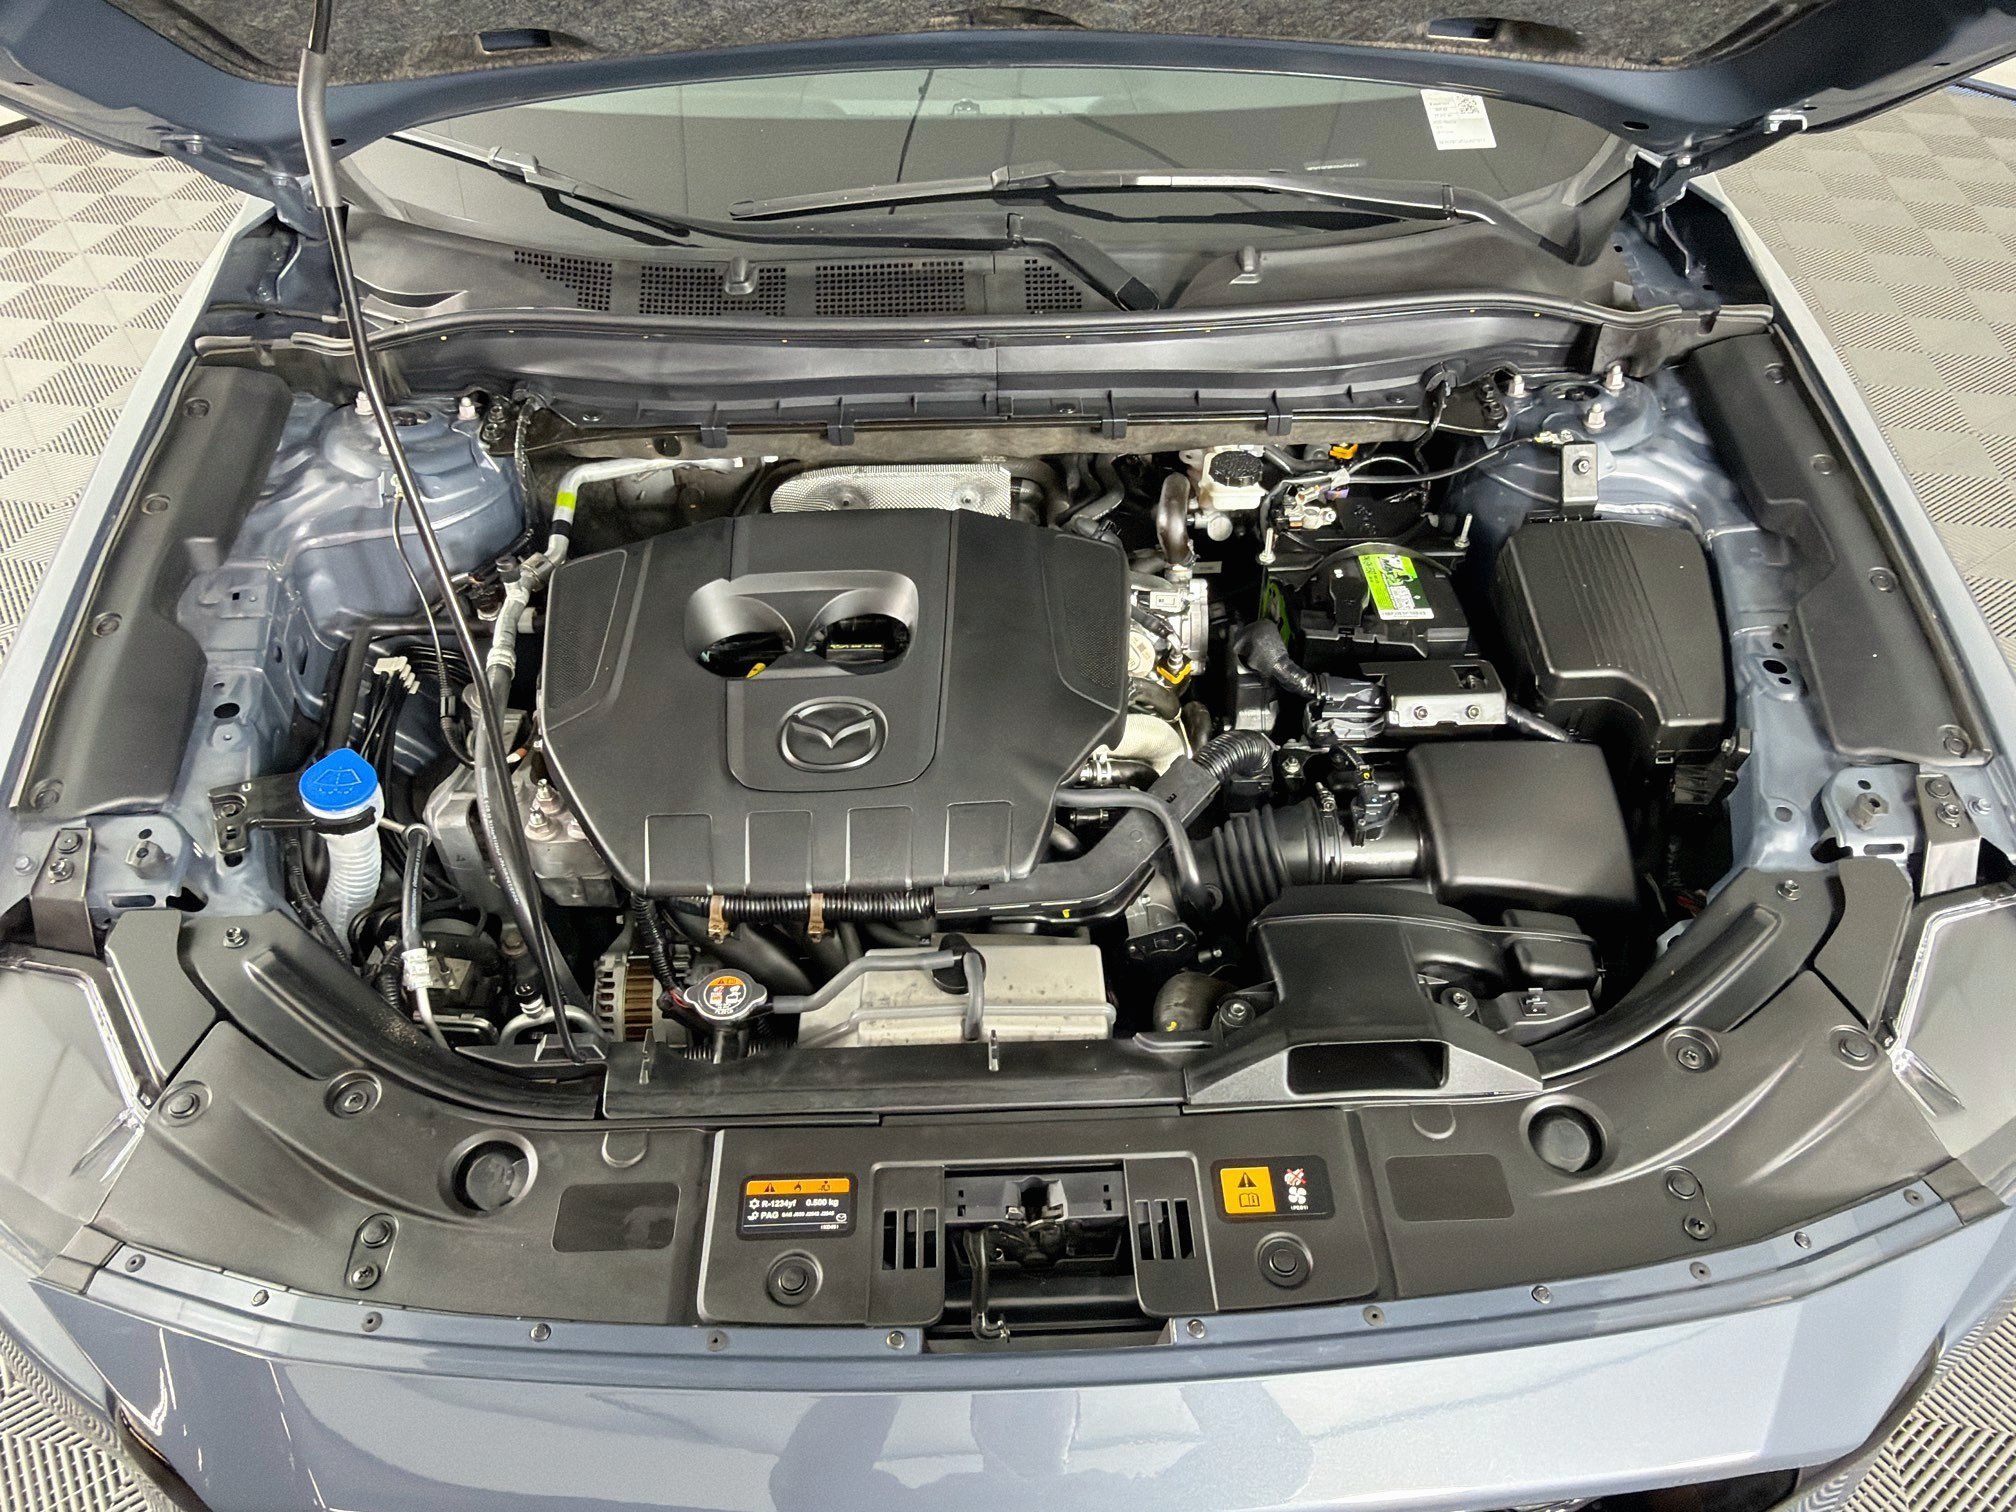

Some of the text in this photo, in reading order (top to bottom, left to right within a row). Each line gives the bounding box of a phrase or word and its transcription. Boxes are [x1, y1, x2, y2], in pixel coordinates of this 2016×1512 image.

[761, 1198, 840, 1209] R-1234yf 0.500 kg
[760, 1211, 779, 1220] PAG
